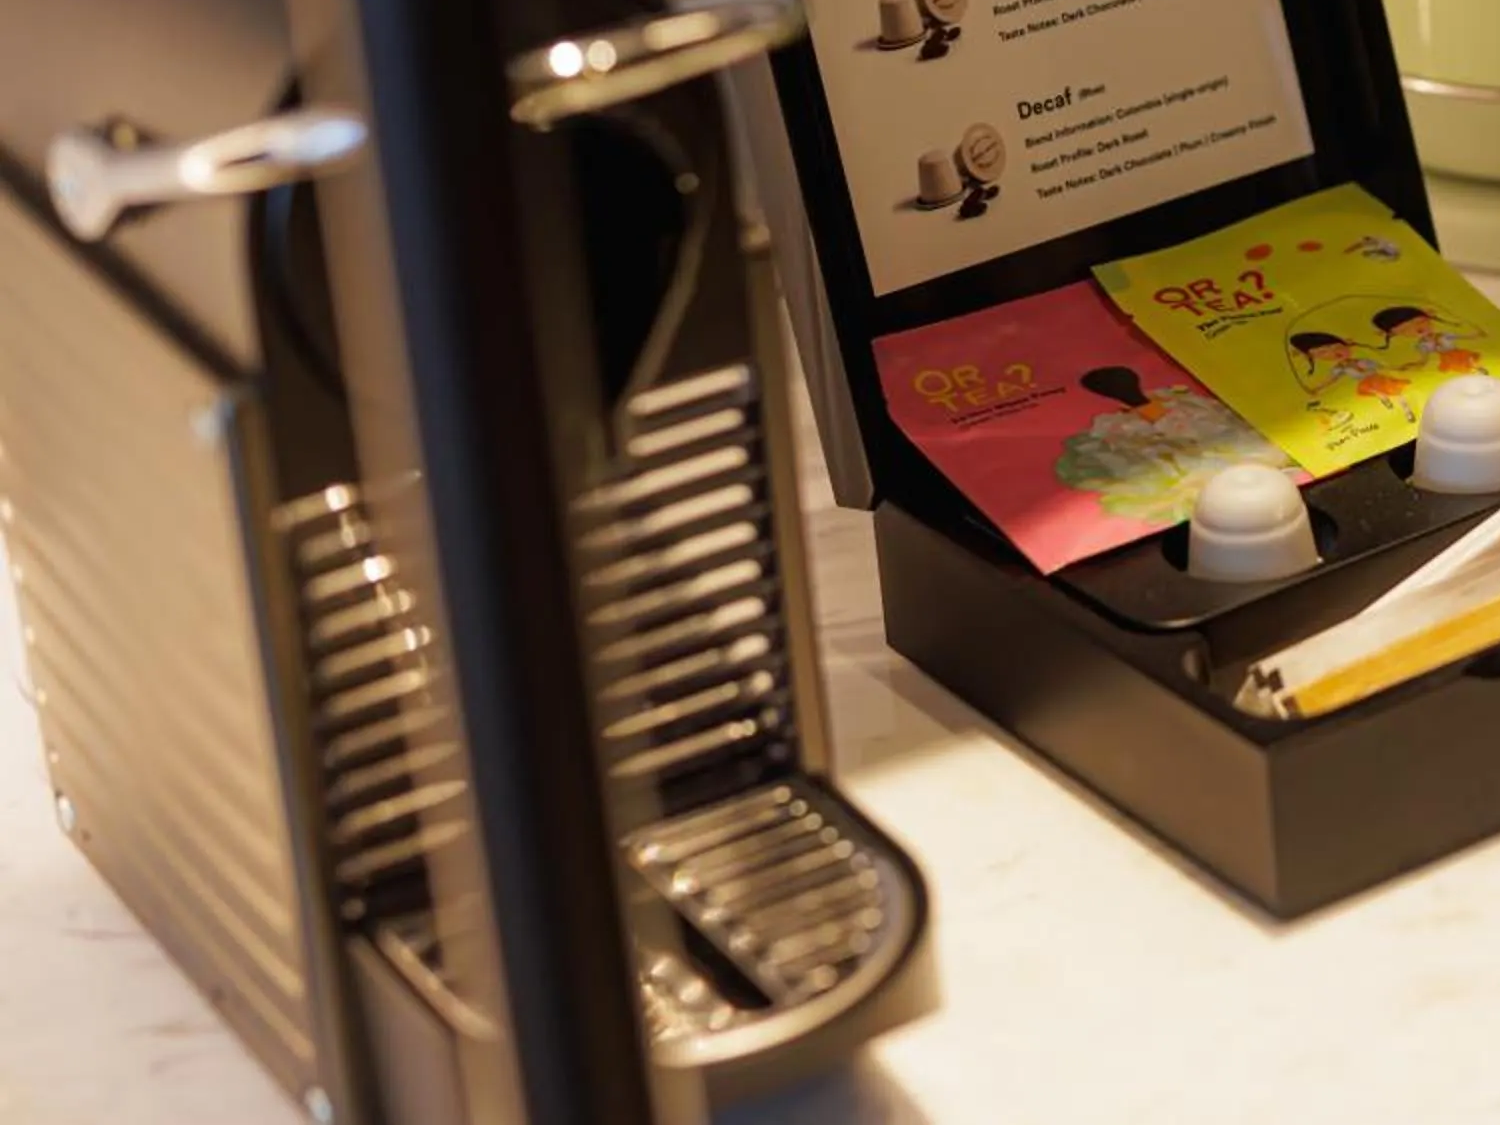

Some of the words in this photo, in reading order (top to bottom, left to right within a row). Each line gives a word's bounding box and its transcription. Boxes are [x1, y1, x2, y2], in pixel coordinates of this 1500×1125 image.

[992, 0, 1020, 16] Roast
[998, 28, 1025, 41] Taste
[1026, 17, 1058, 32] Notes:
[1061, 8, 1084, 23] Dark
[1016, 85, 1073, 121] Decaf
[1054, 114, 1113, 138] Information:
[1115, 99, 1162, 119] Colombia
[1030, 157, 1058, 173] Roast
[1059, 148, 1094, 163] Profile:
[1096, 138, 1120, 152] Dark
[1121, 128, 1148, 143] Roast
[1036, 185, 1063, 198] Taste
[1064, 174, 1096, 189] Notes:
[1098, 165, 1122, 179] Dark
[1123, 149, 1172, 171] Chocolate
[1153, 278, 1222, 306] OR
[1170, 269, 1275, 317] TEA?
[913, 364, 986, 396] OR
[929, 363, 1038, 413] TEA?
